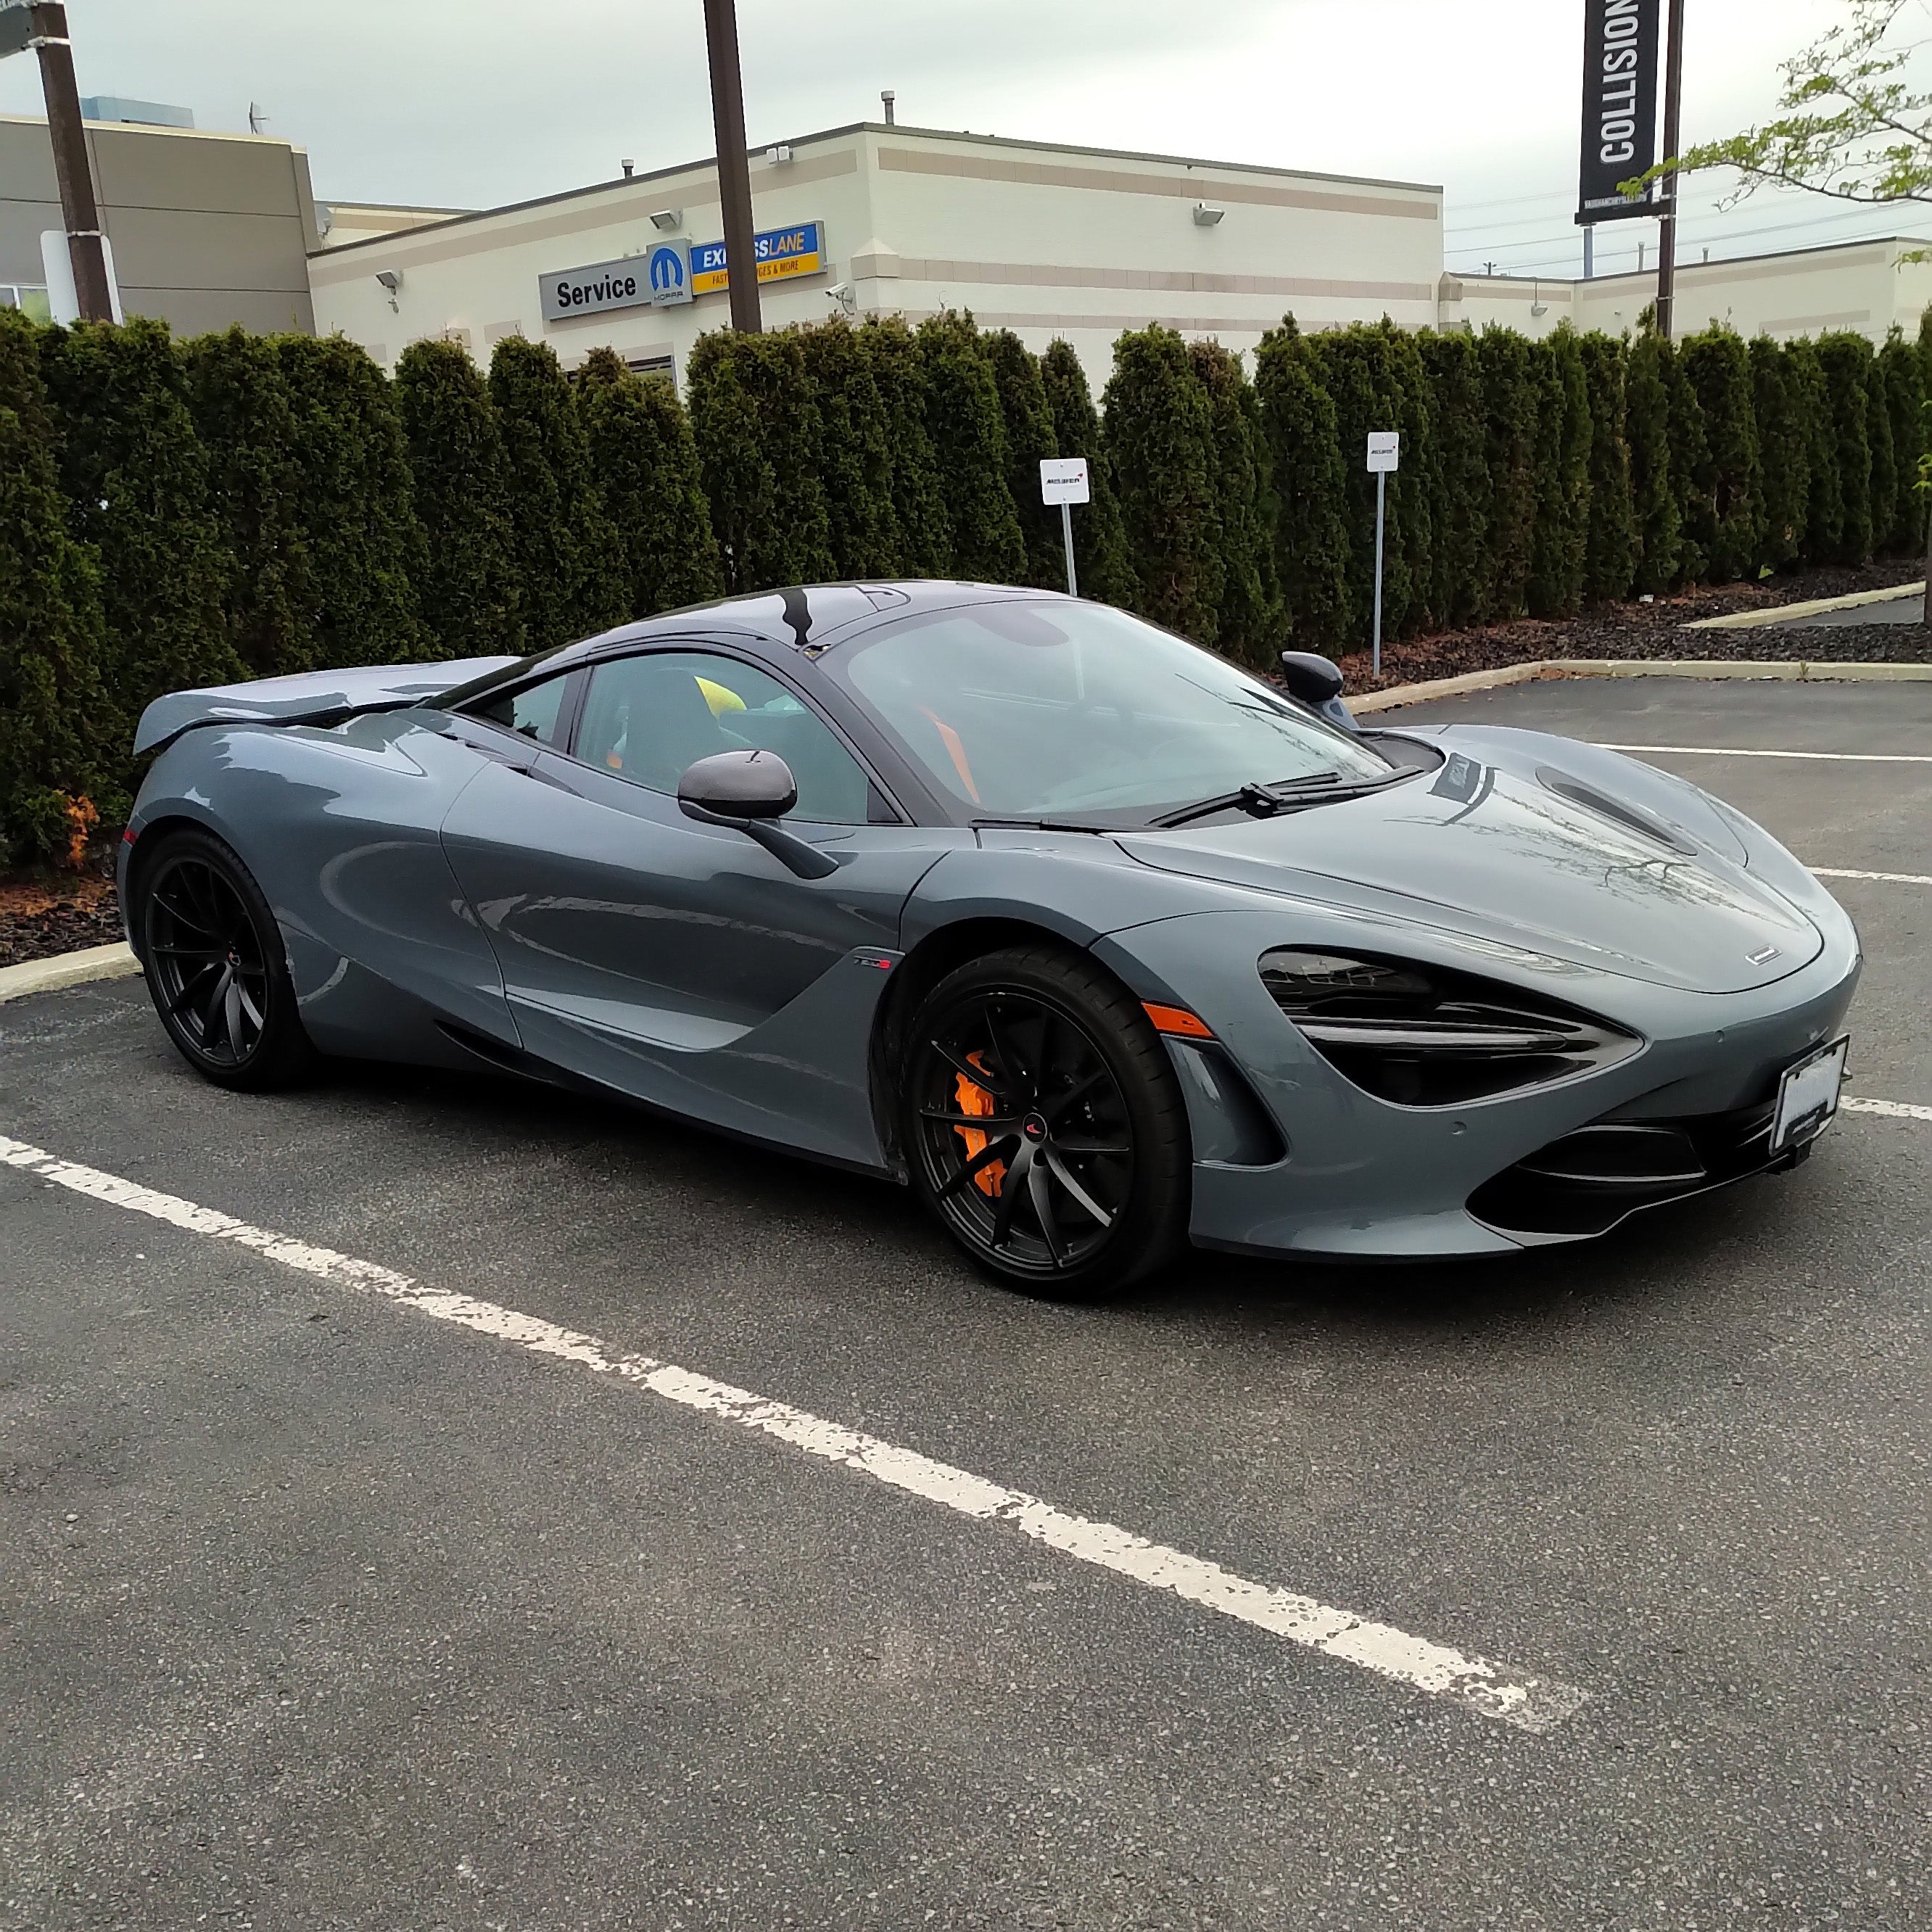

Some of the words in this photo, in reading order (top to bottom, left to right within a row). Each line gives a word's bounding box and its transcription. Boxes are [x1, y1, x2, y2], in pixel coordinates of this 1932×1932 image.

[1600, 0, 1639, 163] COLLISION
[780, 260, 798, 273] MORE
[557, 274, 636, 307] Service
